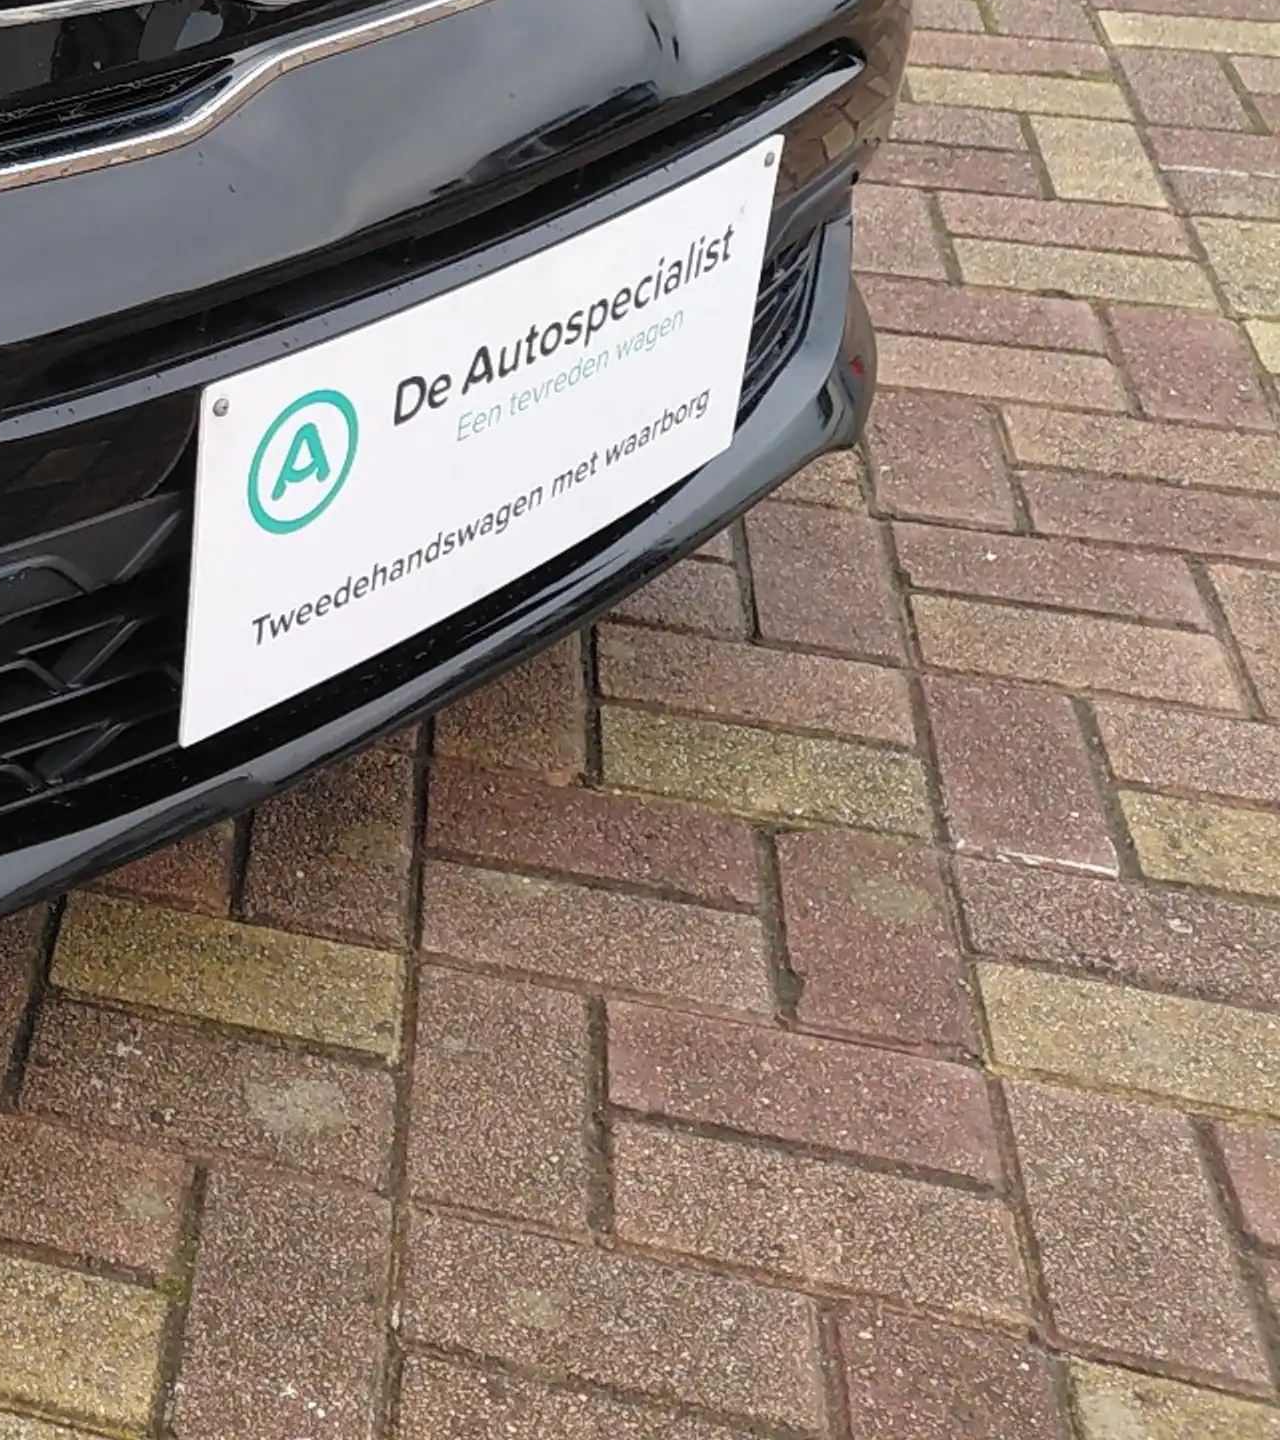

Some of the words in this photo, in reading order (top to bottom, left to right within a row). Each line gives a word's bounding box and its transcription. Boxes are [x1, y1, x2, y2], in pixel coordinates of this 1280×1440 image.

[393, 374, 453, 427] De
[461, 223, 736, 396] Autospecialist
[456, 402, 503, 442] Een
[509, 347, 611, 417] tevreden
[615, 308, 685, 361] wagen
[252, 485, 543, 646] Tweedehandswagen
[551, 451, 599, 496] met
[604, 387, 711, 468] waarborg
